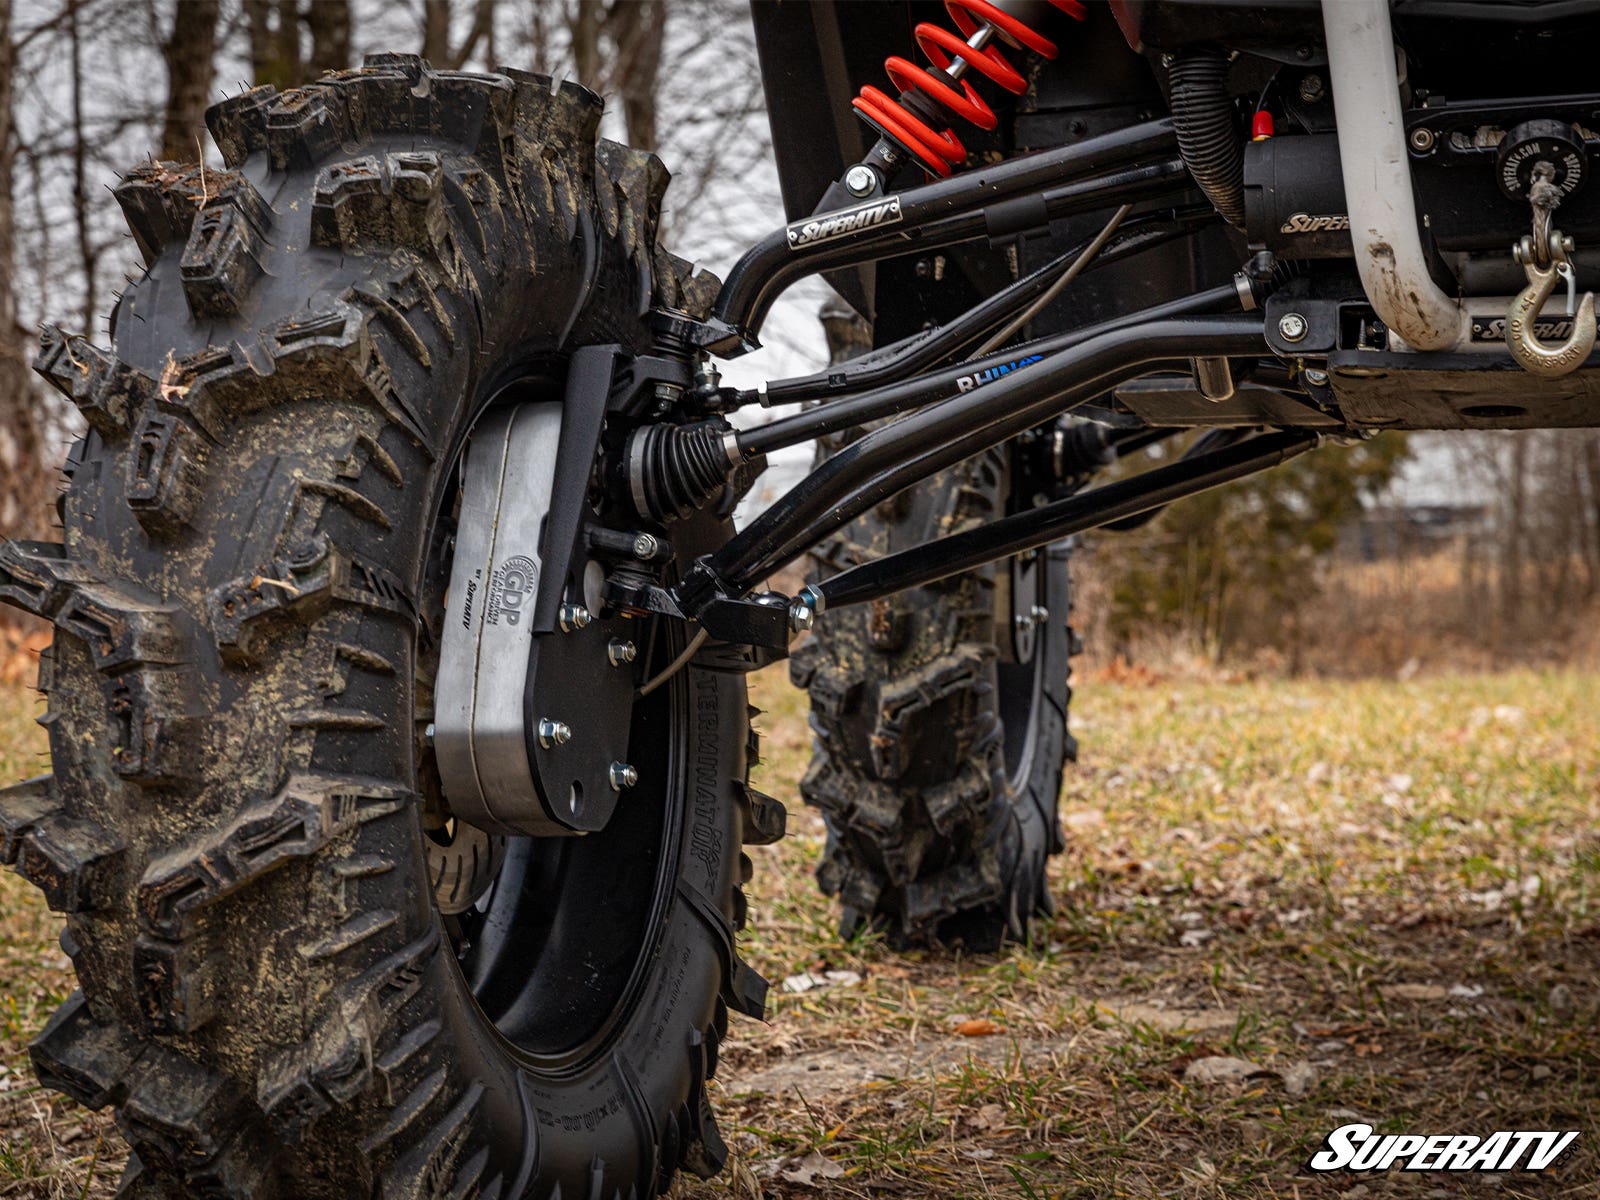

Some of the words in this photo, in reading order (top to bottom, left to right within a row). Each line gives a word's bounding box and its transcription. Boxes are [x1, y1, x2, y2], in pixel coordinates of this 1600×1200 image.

[1519, 343, 1582, 368] TRANSPORT
[500, 571, 525, 626] GDP
[690, 675, 719, 858] TERMINATOR
